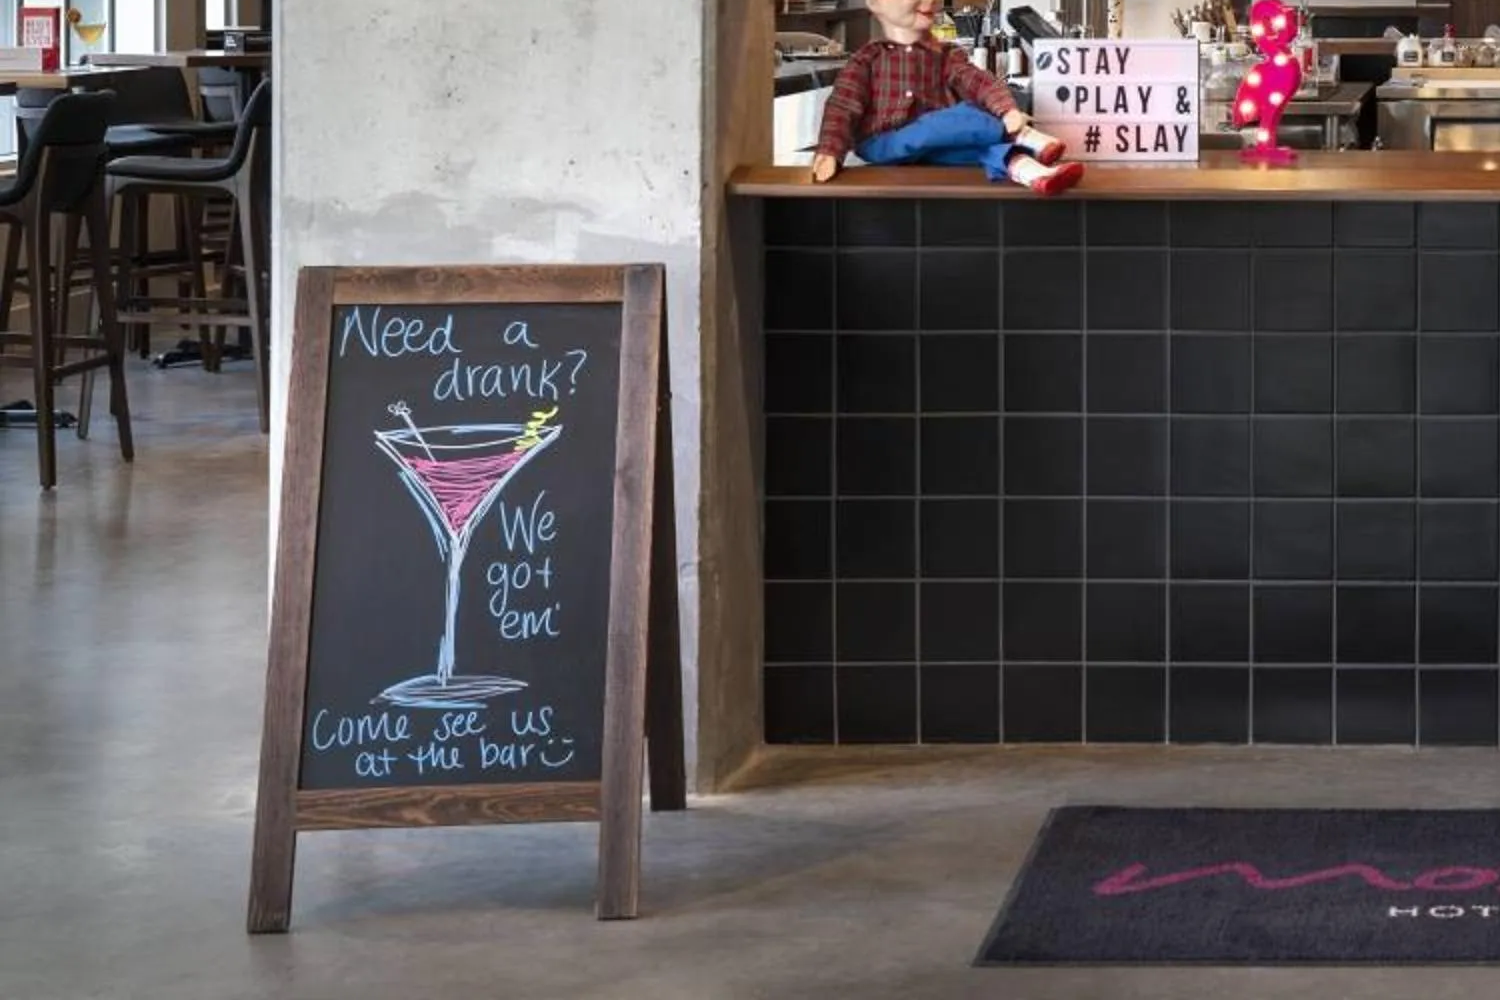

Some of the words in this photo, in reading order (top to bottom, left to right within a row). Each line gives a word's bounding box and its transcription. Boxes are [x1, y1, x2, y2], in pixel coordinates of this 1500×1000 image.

[1057, 47, 1131, 75] STAY
[1075, 85, 1152, 114] PLAY
[1176, 85, 1190, 114] &
[339, 306, 462, 358] Need
[504, 320, 540, 348] a
[433, 348, 588, 401] drank?
[500, 490, 558, 553] We
[487, 556, 554, 617] got
[312, 708, 412, 751] Come
[433, 710, 487, 738] see
[511, 705, 553, 736] us
[355, 751, 398, 777] at
[408, 744, 465, 774] the
[480, 738, 536, 770] bar
